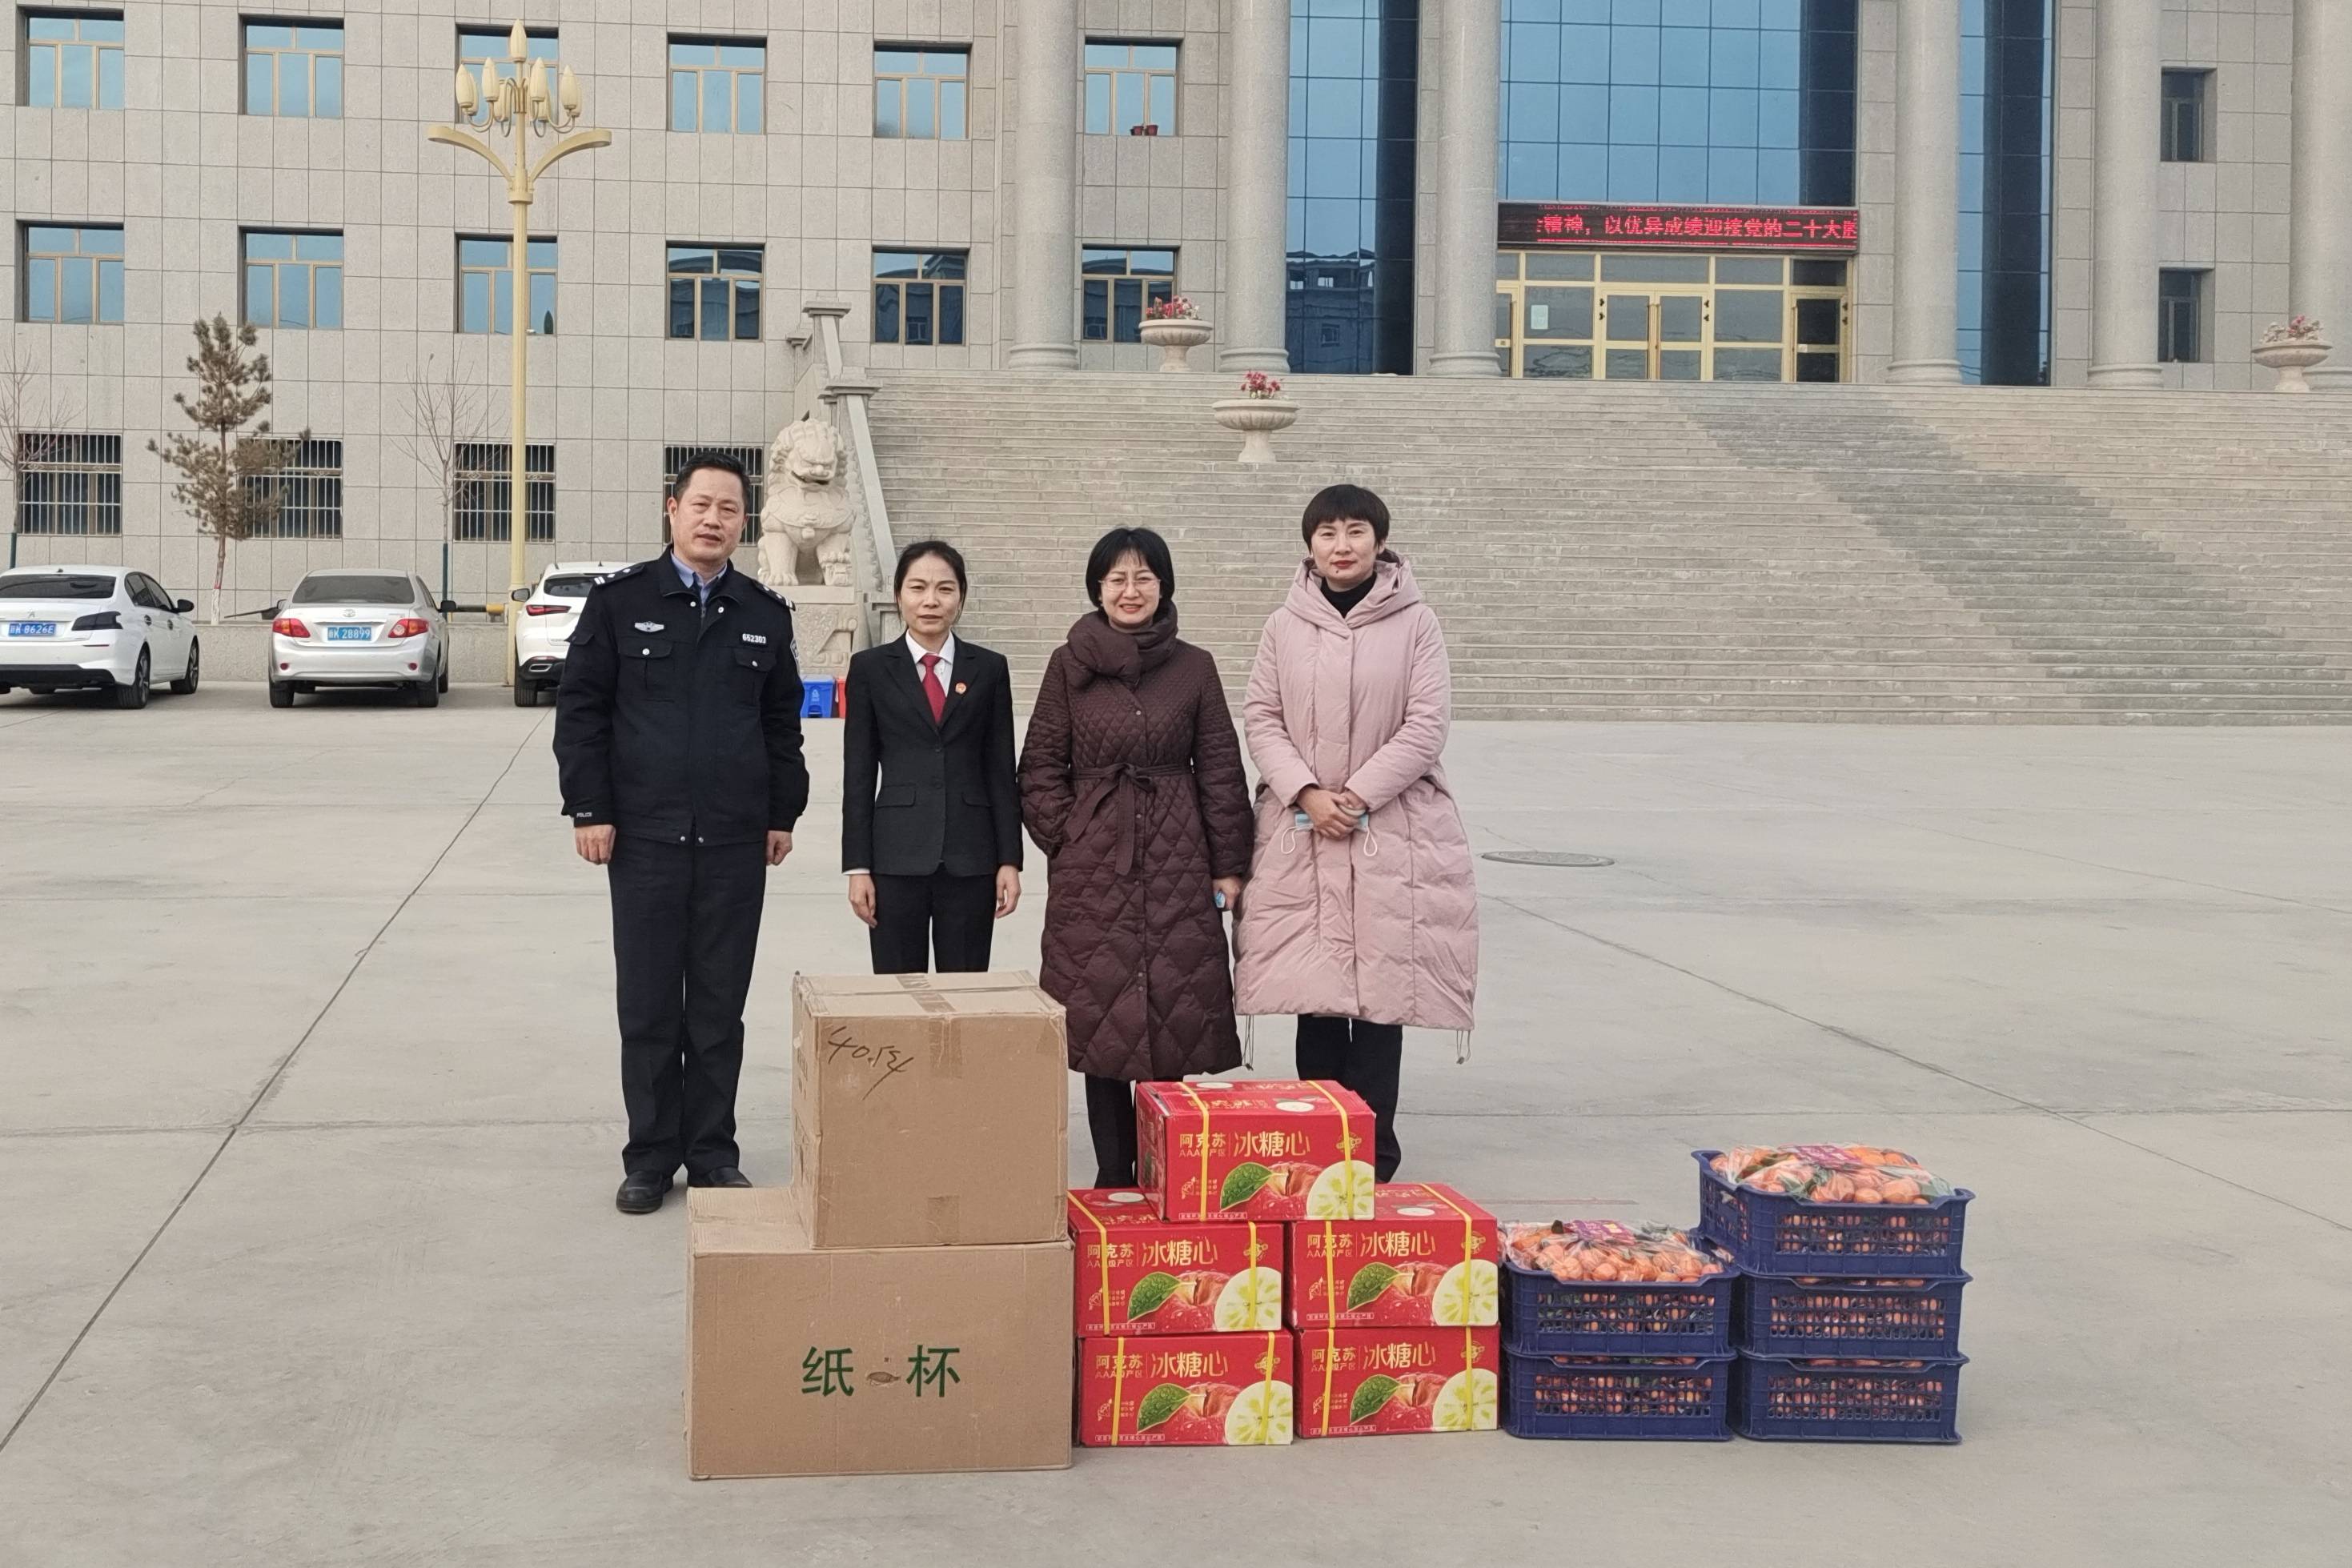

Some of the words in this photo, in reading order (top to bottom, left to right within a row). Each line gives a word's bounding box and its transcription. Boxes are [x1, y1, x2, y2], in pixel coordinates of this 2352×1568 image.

[1179, 1133, 1226, 1148] 阿克苏
[1234, 1130, 1310, 1157] 冰糖心
[1087, 1243, 1134, 1259] 阿克苏
[1142, 1236, 1218, 1267] 冰糖心
[1307, 1233, 1353, 1249] 阿克苏
[1360, 1230, 1435, 1258] 冰糖心
[1096, 1353, 1143, 1369] 阿克苏
[1150, 1349, 1228, 1378] 冰糖心
[1311, 1346, 1356, 1363] 阿克苏
[1363, 1341, 1436, 1370] 冰糖心
